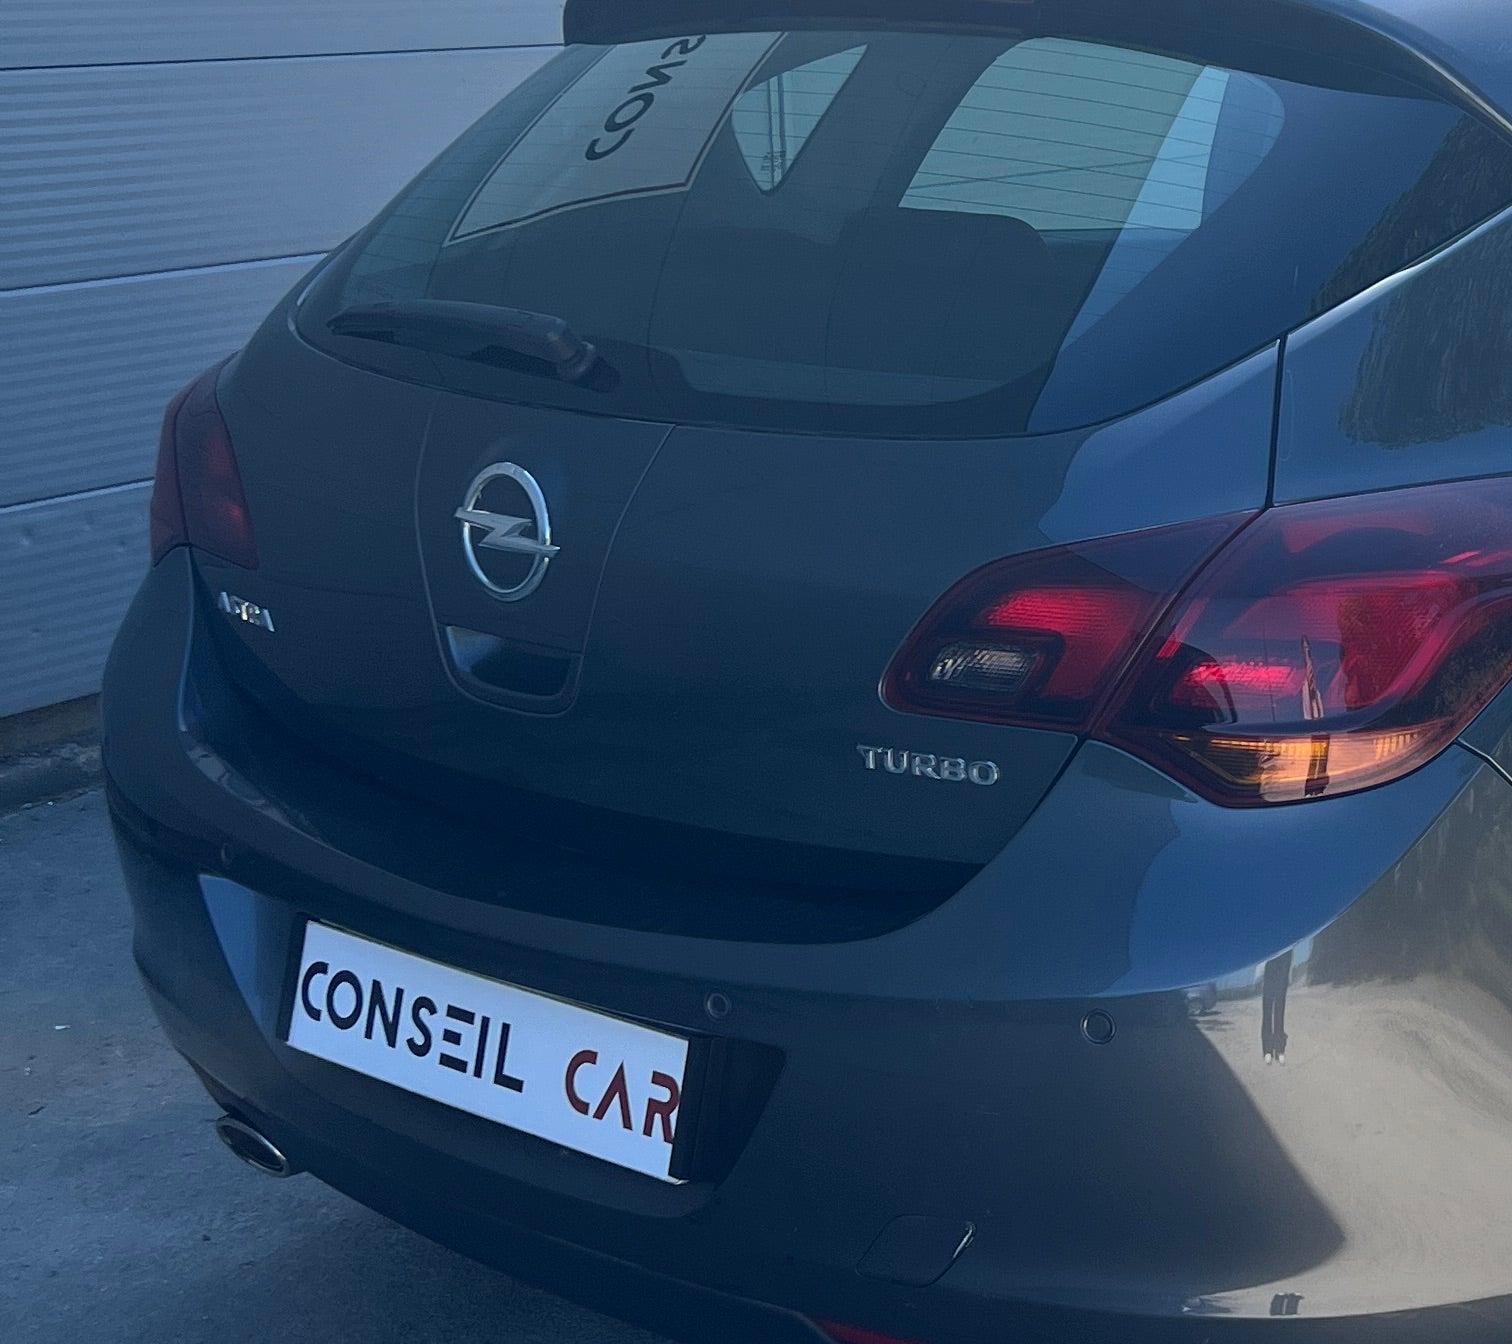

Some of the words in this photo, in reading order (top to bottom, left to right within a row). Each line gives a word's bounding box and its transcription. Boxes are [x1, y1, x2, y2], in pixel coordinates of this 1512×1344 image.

[856, 743, 1000, 786] TURBO
[301, 961, 525, 1093] CONSEIL
[565, 1049, 680, 1145] CAR
